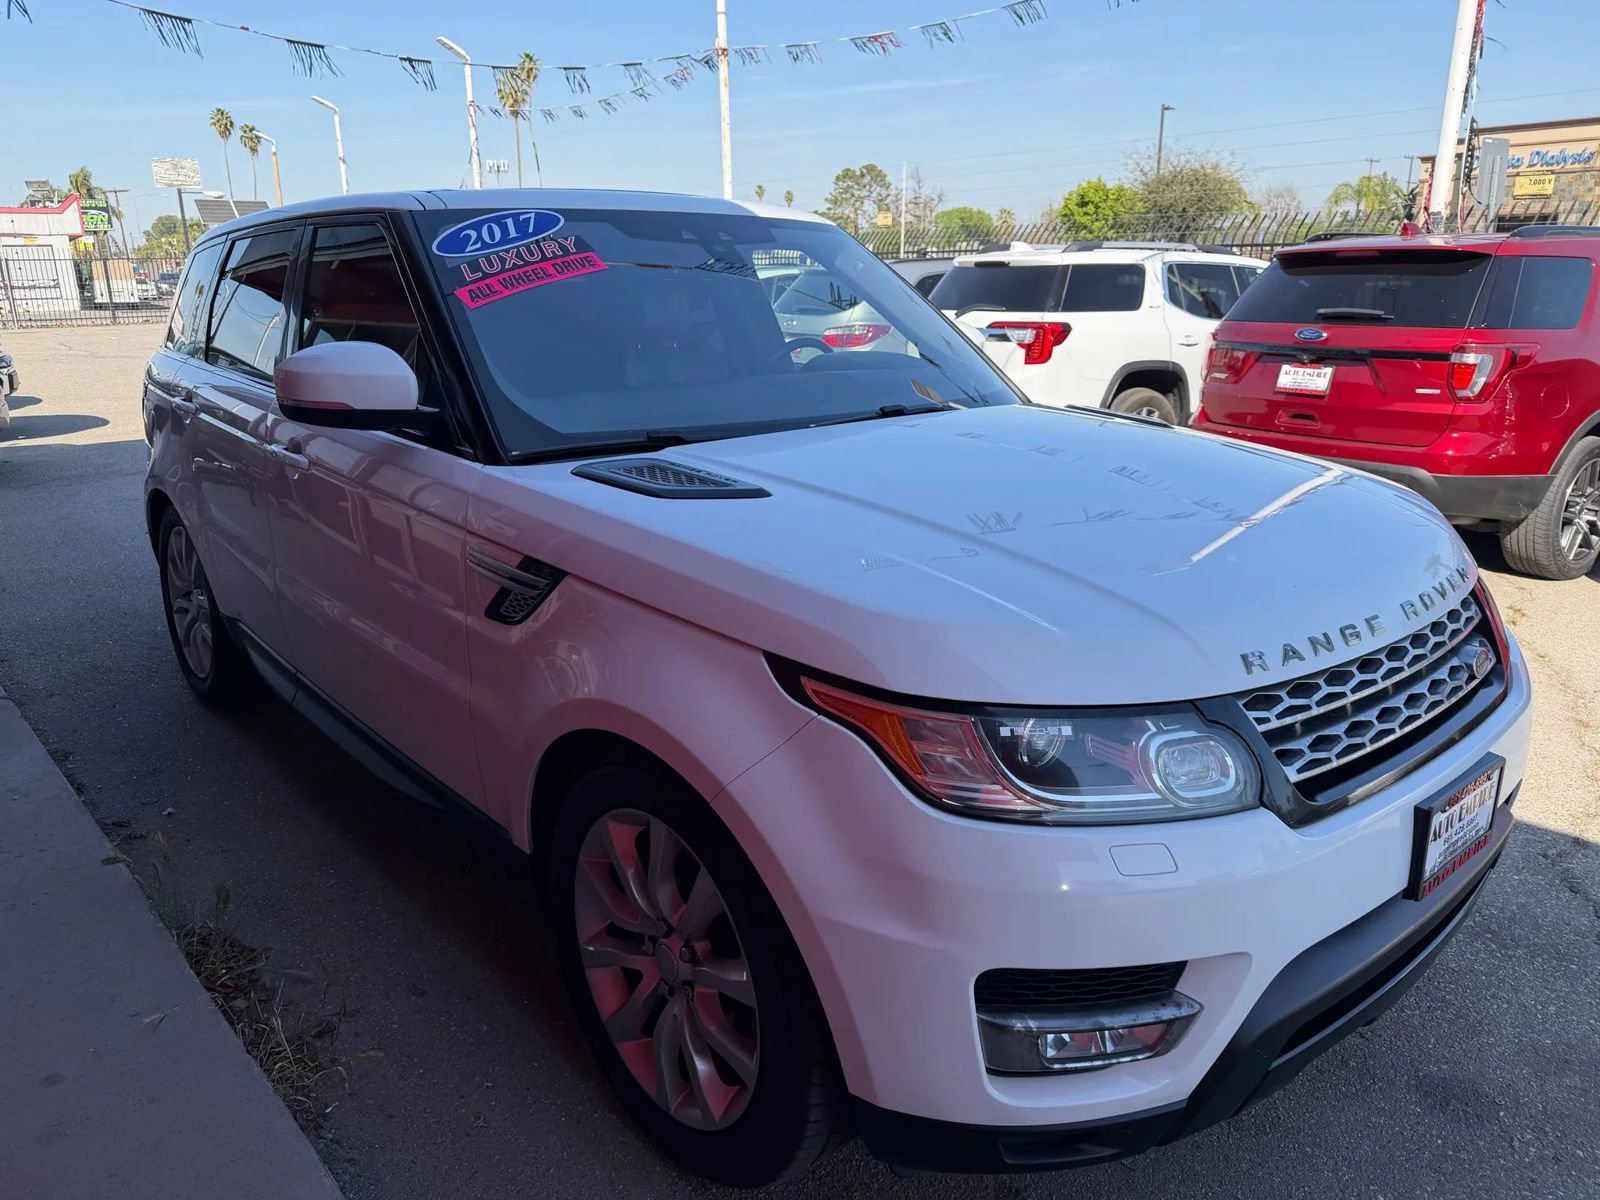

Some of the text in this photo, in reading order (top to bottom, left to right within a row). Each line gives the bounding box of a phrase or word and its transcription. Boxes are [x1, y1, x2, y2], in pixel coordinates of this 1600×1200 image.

[1526, 147, 1595, 169] Dialysis
[459, 212, 537, 253] 2017
[460, 236, 577, 282] LUXURY
[467, 255, 597, 303] ALL WHEEL DRIVE
[1240, 566, 1470, 675] RANGE ROVER
[1430, 780, 1496, 845] AUTO EMPIRE
